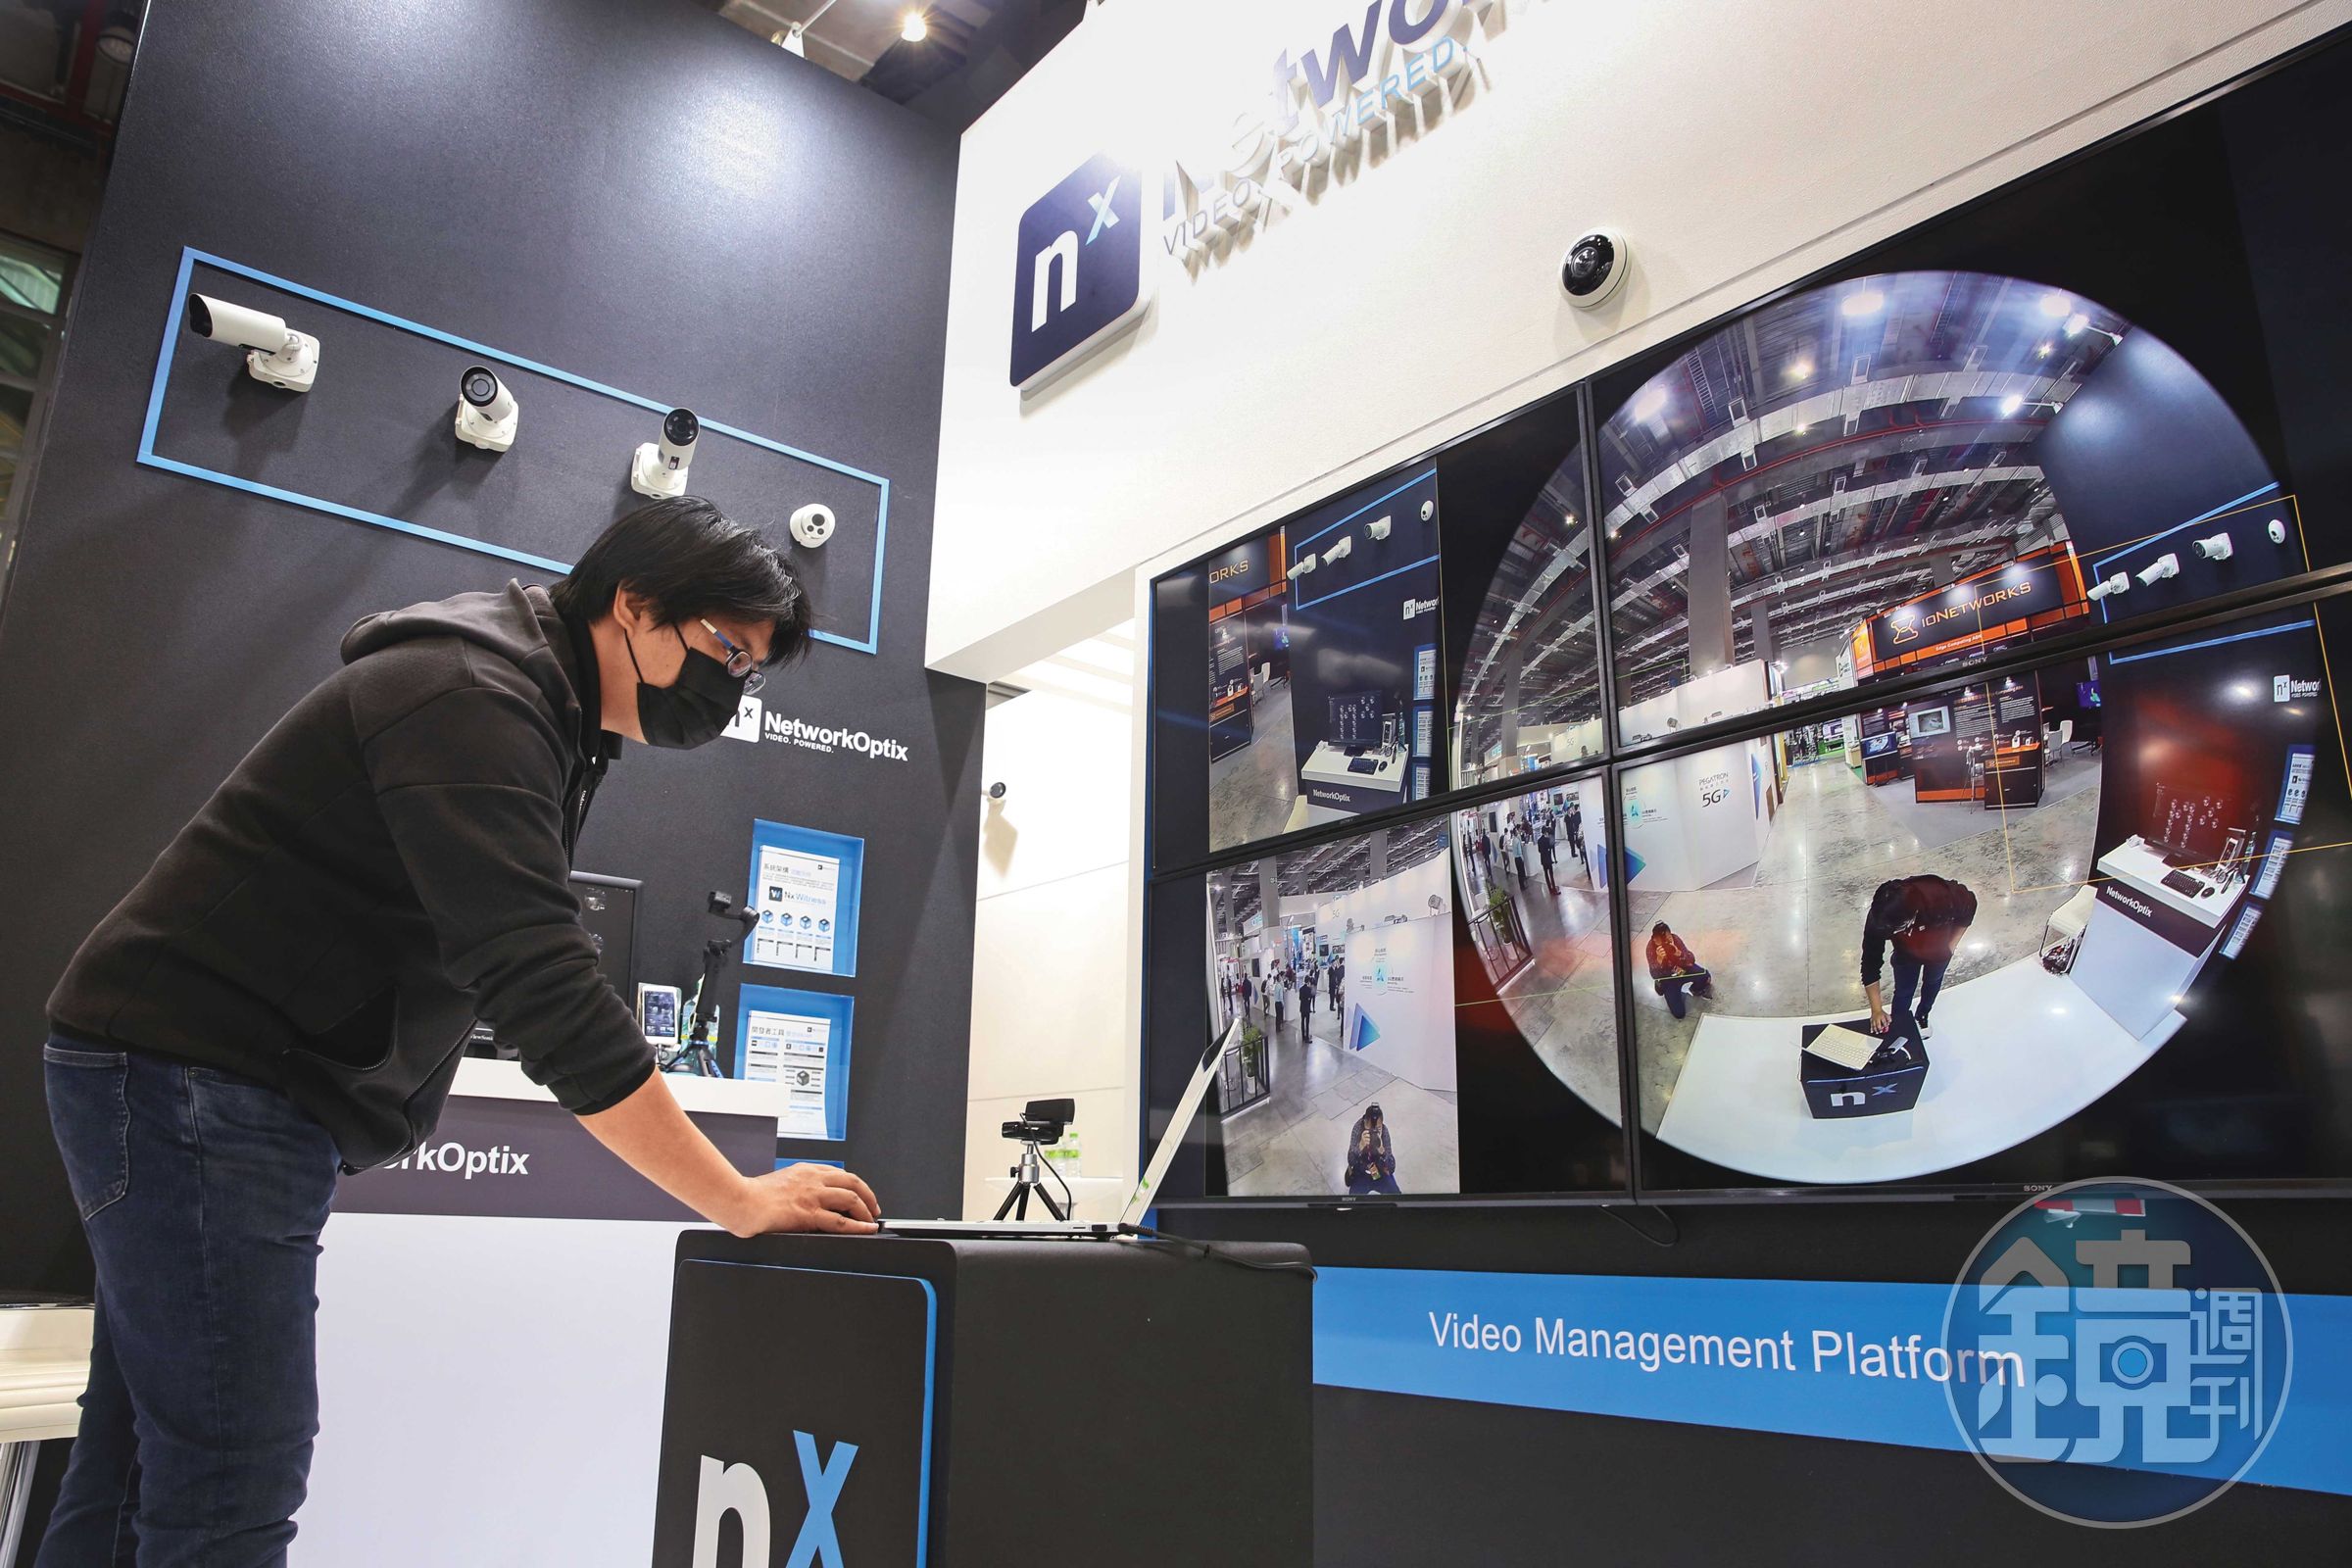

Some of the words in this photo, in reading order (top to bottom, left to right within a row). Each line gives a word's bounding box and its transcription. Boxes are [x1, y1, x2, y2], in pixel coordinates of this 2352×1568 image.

[1209, 560, 1249, 584] ORKS
[1962, 656, 1988, 667] SONY
[764, 710, 908, 761] NetworkOptix
[764, 732, 791, 745] VIDEO.
[793, 738, 834, 754] POWERED.
[1312, 788, 1351, 803] NetworkOptix
[1701, 789, 1722, 808] 5G
[2106, 885, 2153, 918] NetworkOptix
[1428, 1311, 1521, 1353] Video
[1535, 1317, 1795, 1372] Management
[1812, 1330, 2026, 1388] Platform
